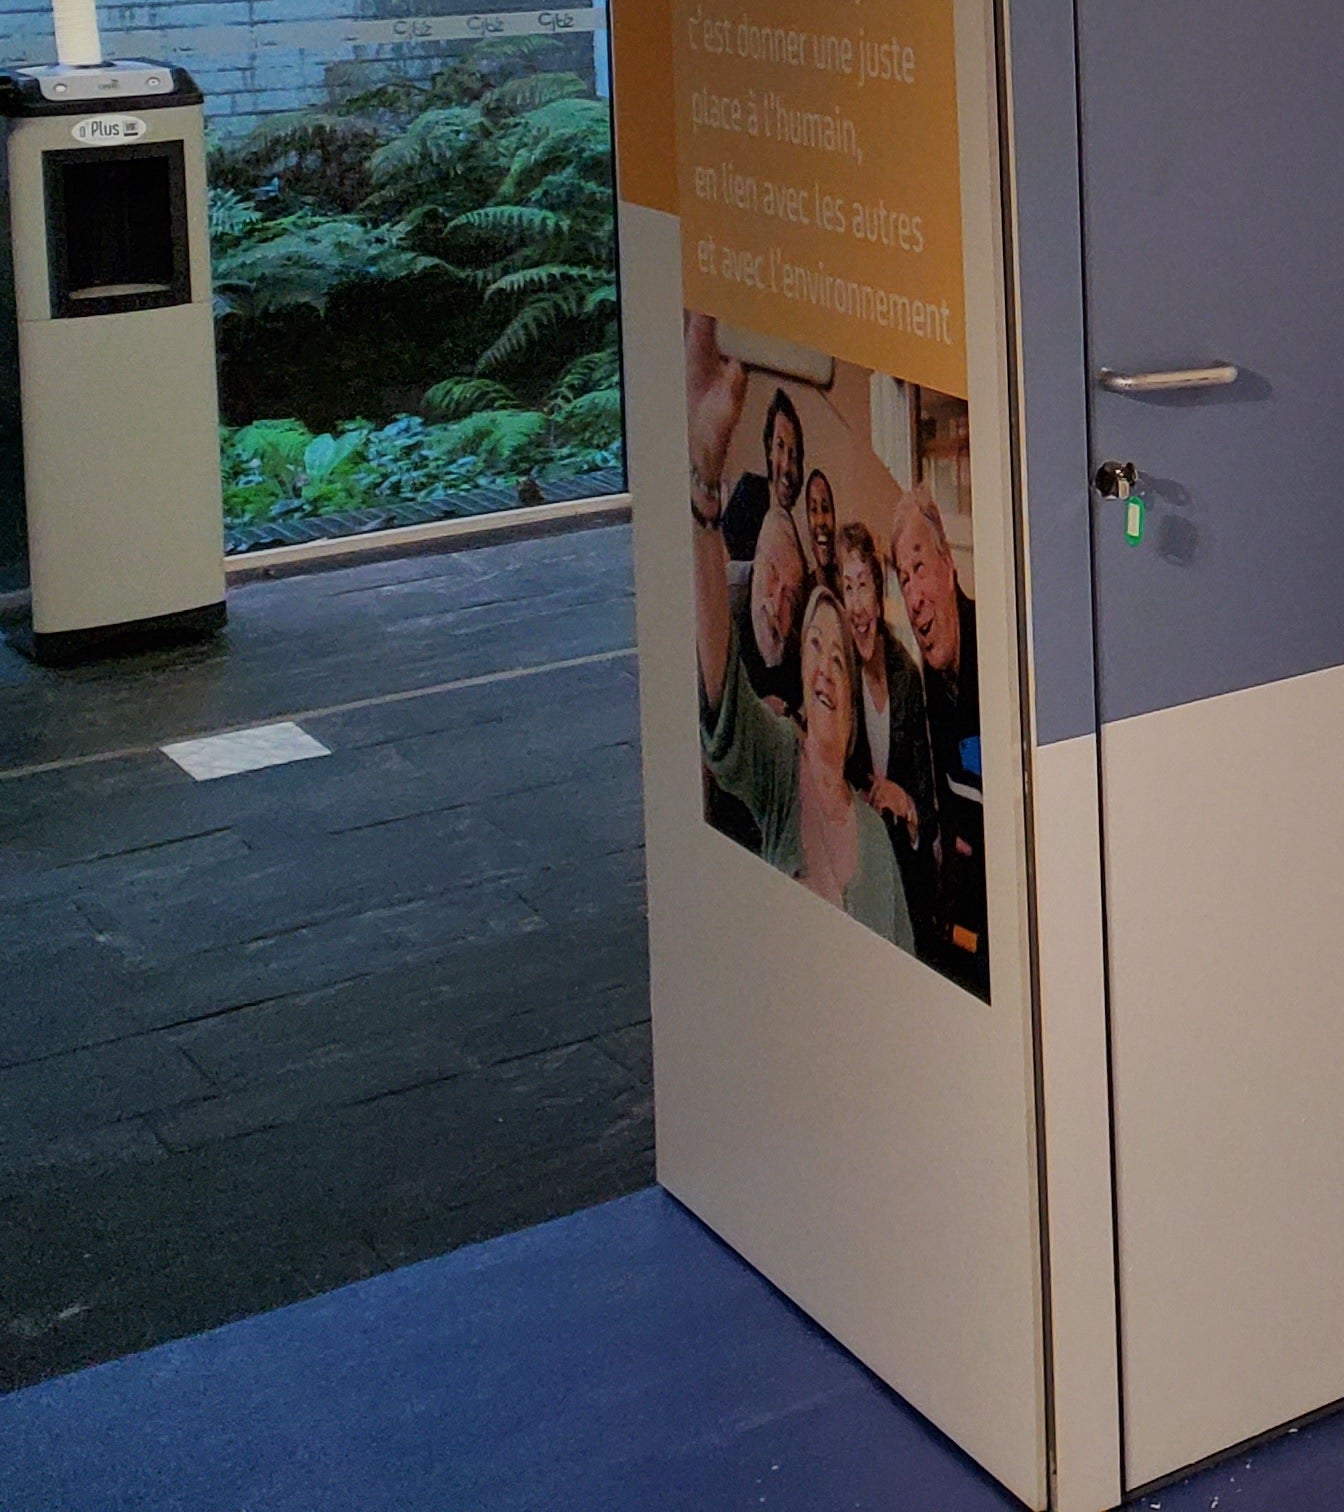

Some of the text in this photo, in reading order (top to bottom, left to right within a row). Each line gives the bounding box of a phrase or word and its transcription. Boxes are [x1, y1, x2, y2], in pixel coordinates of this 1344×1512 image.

[737, 13, 807, 66] donner
[813, 34, 852, 74] une
[857, 28, 915, 87] juste
[91, 121, 119, 136] Plus
[692, 88, 742, 133] place
[748, 90, 758, 137] à
[695, 160, 924, 253] en lien avec les autres
[697, 235, 716, 275] et
[720, 245, 765, 290] avec
